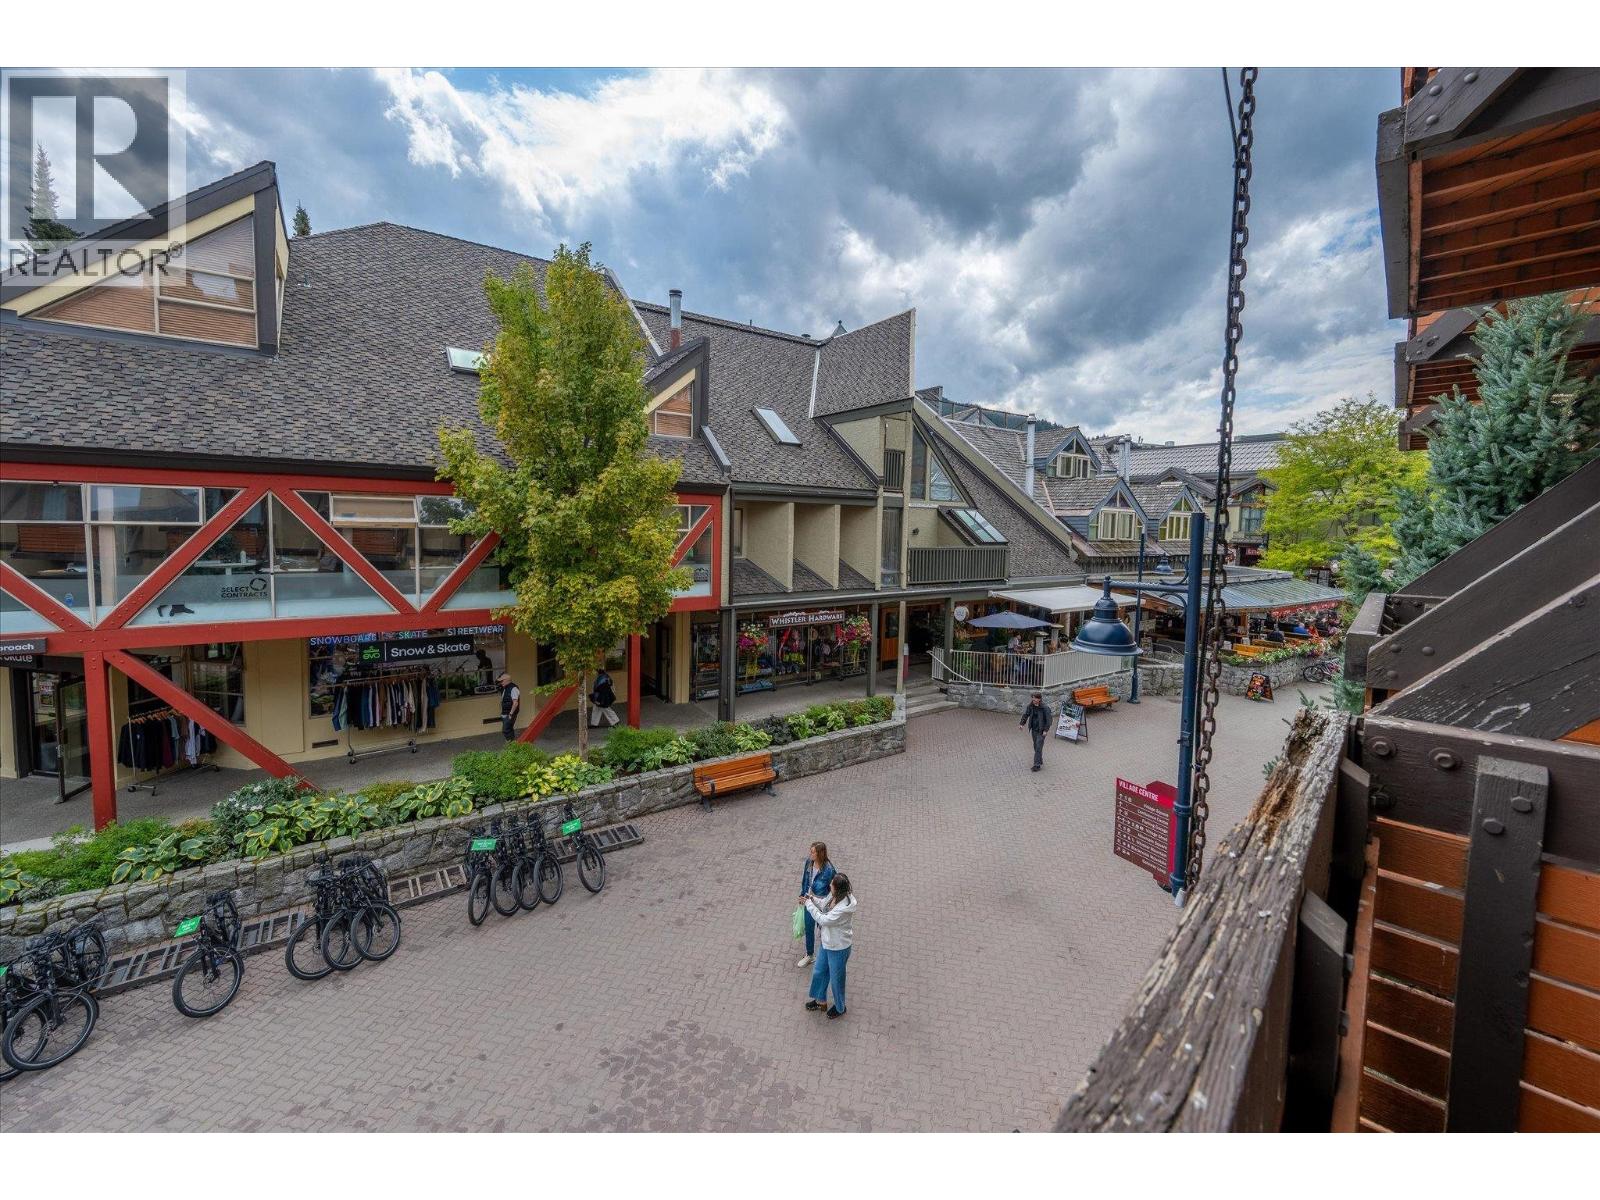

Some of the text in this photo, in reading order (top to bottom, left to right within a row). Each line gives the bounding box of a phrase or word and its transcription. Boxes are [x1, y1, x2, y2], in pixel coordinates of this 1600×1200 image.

[398, 630, 428, 640] SKATE
[363, 643, 471, 660] evo Snow & Skate
[1119, 780, 1159, 802] VILLAGE CENTRE
